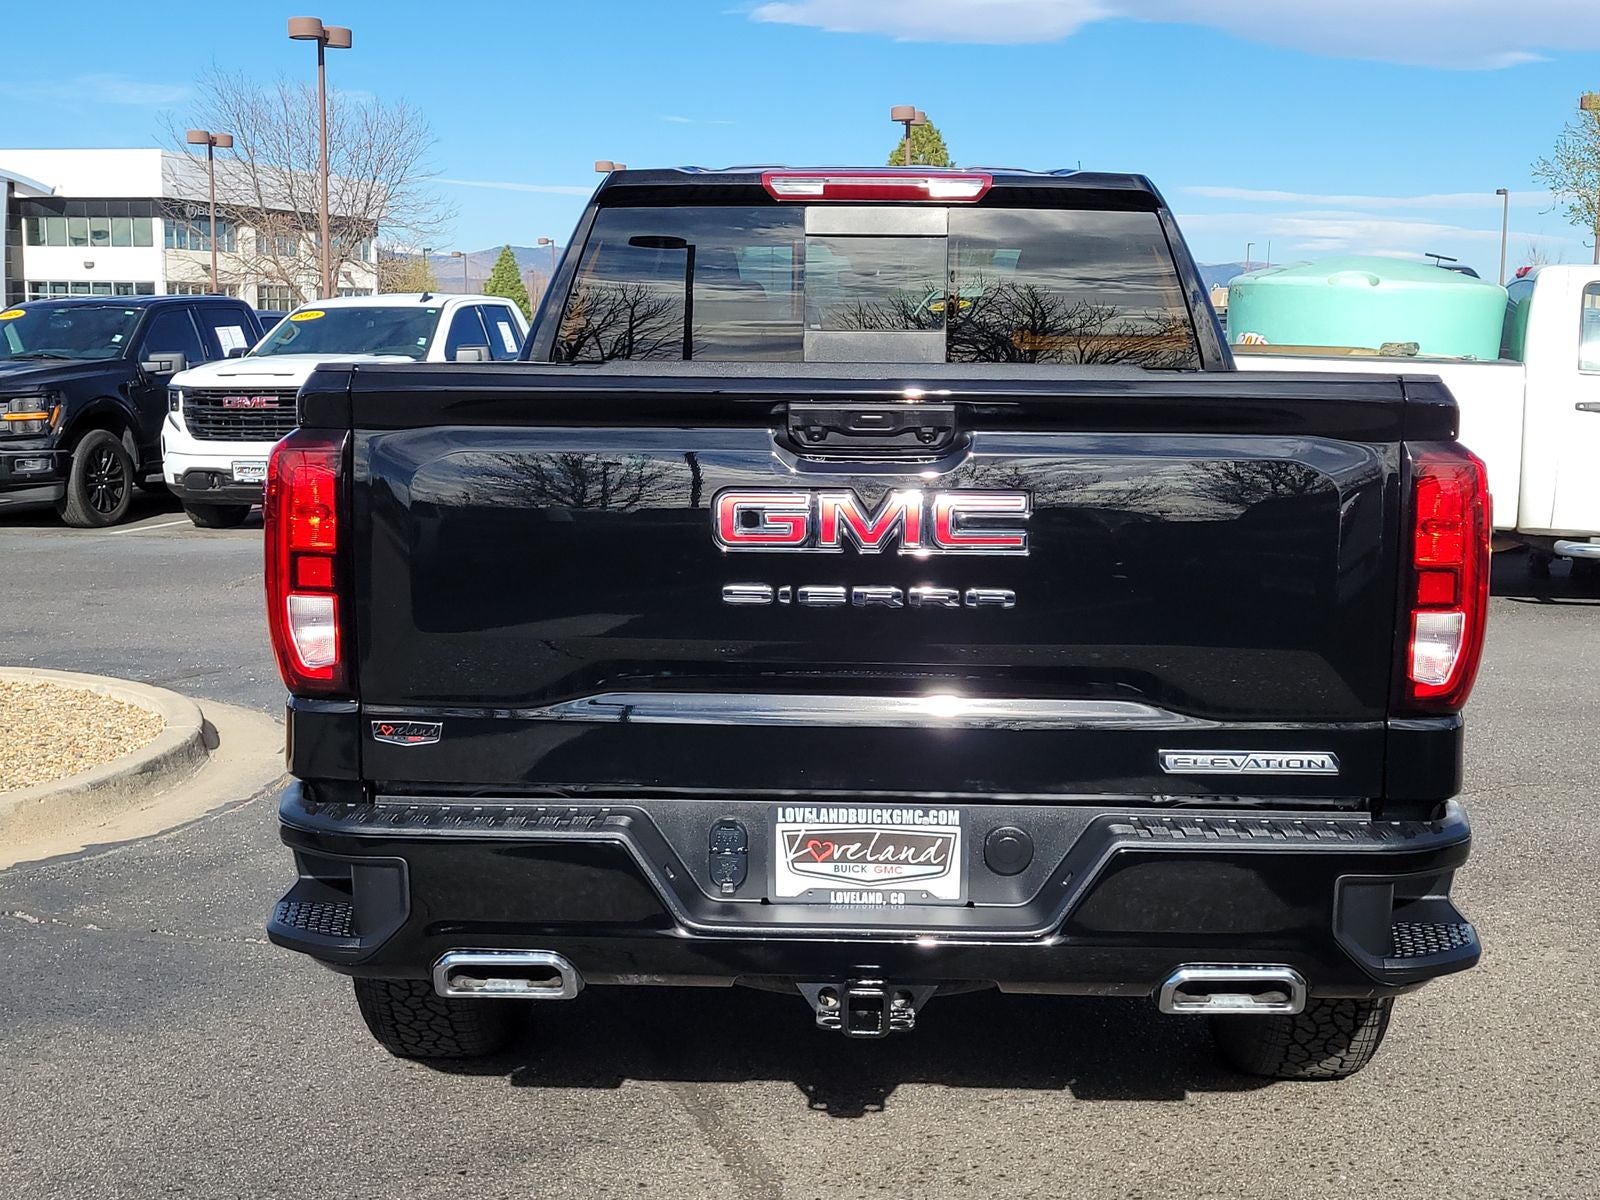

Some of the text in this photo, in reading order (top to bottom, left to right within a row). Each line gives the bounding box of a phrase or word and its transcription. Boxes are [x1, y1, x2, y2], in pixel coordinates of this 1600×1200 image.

[223, 396, 279, 409] GMC
[712, 487, 1033, 556] GMC
[722, 583, 1016, 609] SIERRA
[1173, 757, 1327, 769] ELEVATION
[833, 864, 903, 875] BUICK GMC
[830, 890, 905, 905] LOVELAND, CO
